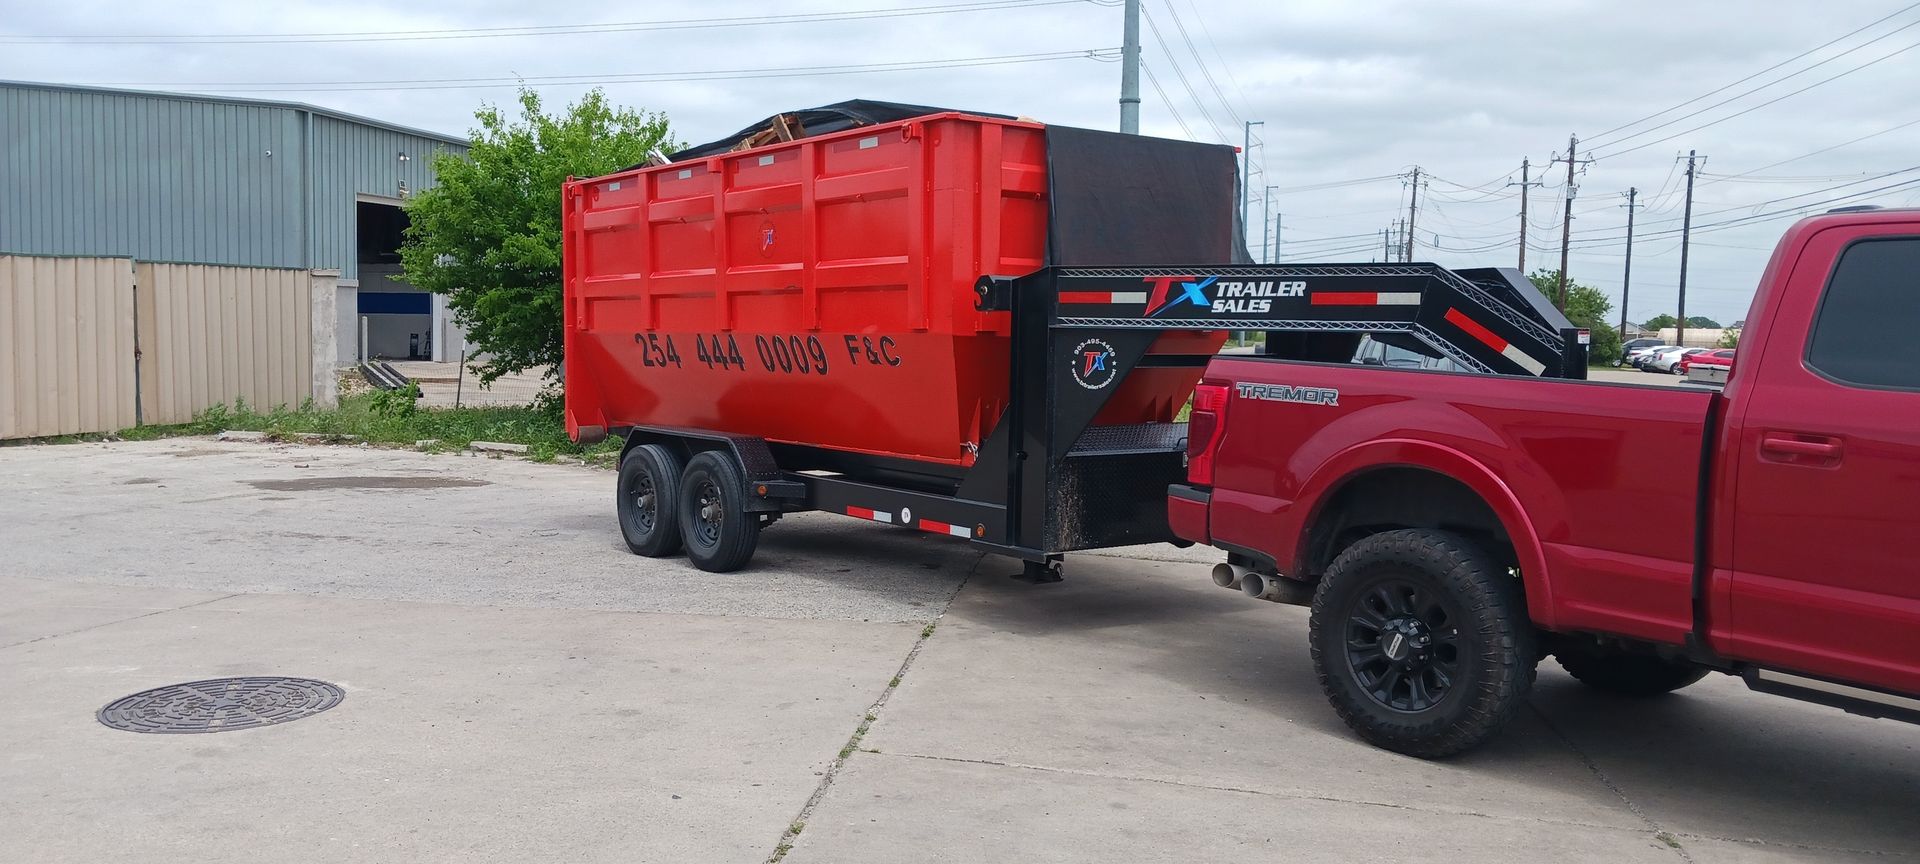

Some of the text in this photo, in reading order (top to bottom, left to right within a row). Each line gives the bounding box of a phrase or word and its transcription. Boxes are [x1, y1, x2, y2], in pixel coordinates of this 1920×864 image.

[1216, 281, 1307, 297] TRAILER
[1211, 299, 1272, 313] SALES
[634, 333, 901, 375] 254 444 0009 F&C
[1083, 351, 1109, 378] TX
[1236, 381, 1339, 407] TREMOR
